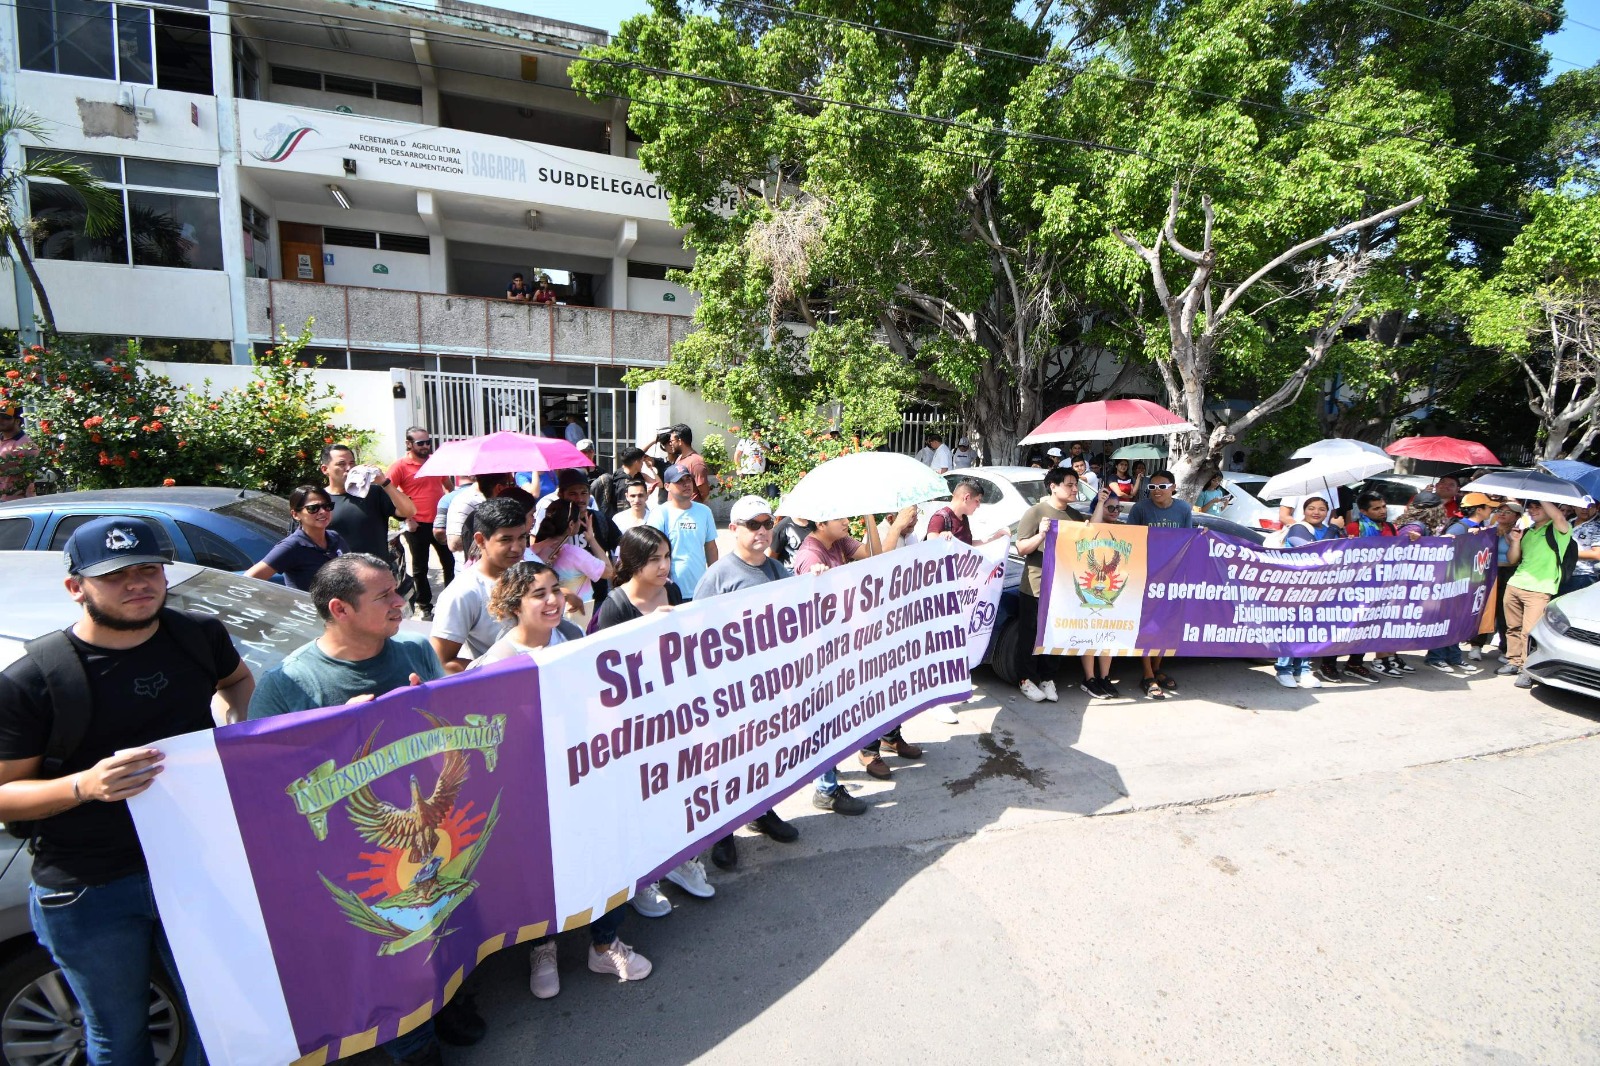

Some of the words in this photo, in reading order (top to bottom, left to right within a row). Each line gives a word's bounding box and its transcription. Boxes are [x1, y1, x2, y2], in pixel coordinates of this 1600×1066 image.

[349, 143, 387, 155] ANADERIA
[390, 149, 437, 162] DESARROLLO
[438, 155, 461, 165] RURAL
[359, 134, 398, 147] ECRETARIA
[411, 142, 461, 155] AGRICULTURA
[379, 157, 401, 166] PESCA
[410, 162, 464, 174] ALIMENTACION
[471, 151, 527, 183] SAGARPA
[1208, 538, 1236, 559] Los
[1344, 547, 1385, 565] pesos
[1228, 564, 1238, 580] a
[1239, 564, 1259, 581] la
[1260, 565, 1355, 585] construcción
[1354, 565, 1372, 582] de
[1148, 582, 1165, 599] se
[1167, 581, 1238, 601] perderán
[1239, 586, 1266, 602] por
[1265, 585, 1284, 602] la
[1283, 586, 1316, 603] falta
[1317, 586, 1337, 602] de
[1337, 584, 1407, 604] respuesta
[1409, 583, 1431, 601] de
[1054, 617, 1089, 630] SOMOS
[1090, 618, 1135, 631] GRANDES
[1233, 604, 1296, 625] ¡Exigimos
[1298, 604, 1313, 622] la
[1316, 601, 1401, 622] autorización
[1402, 602, 1424, 620] de
[596, 649, 653, 708] Sr.
[659, 592, 837, 687] Presidente
[841, 586, 857, 624] y
[860, 574, 884, 613] Sr.
[1183, 623, 1200, 642] la
[1202, 622, 1305, 643] Manifestación
[1307, 624, 1328, 643] de
[1330, 623, 1381, 643] Impacto
[1381, 619, 1451, 639] Ambiental!
[567, 696, 710, 787] pedimos
[713, 680, 746, 718] su
[750, 652, 813, 703] apoyo
[816, 633, 850, 675] para
[853, 620, 883, 651] que
[640, 762, 669, 801] la
[677, 681, 834, 783] Manifestación
[836, 668, 855, 698] de
[859, 638, 921, 685] Impacto
[925, 624, 967, 656] Amb
[725, 776, 741, 805] a
[747, 762, 769, 794] la
[775, 689, 886, 778] Construcción
[888, 679, 907, 706] de
